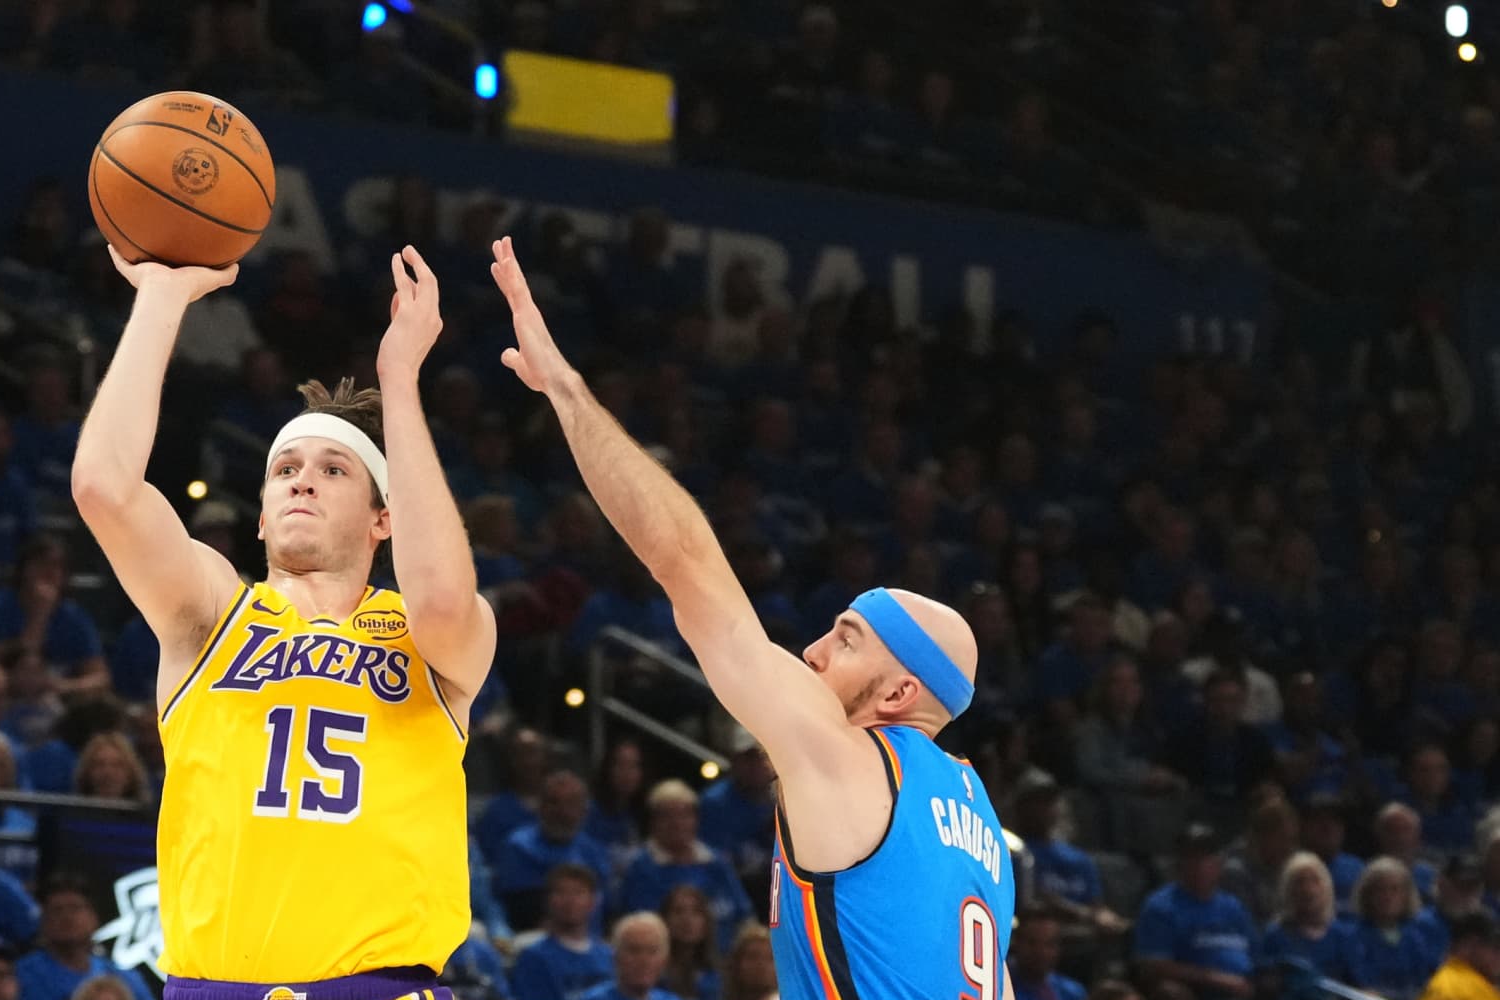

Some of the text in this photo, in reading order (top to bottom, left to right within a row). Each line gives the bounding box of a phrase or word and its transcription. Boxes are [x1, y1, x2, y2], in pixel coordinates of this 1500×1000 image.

[208, 622, 413, 703] LAKERS
[358, 618, 406, 631] bibigo
[252, 705, 368, 824] 15
[930, 797, 1000, 884] CARUSO
